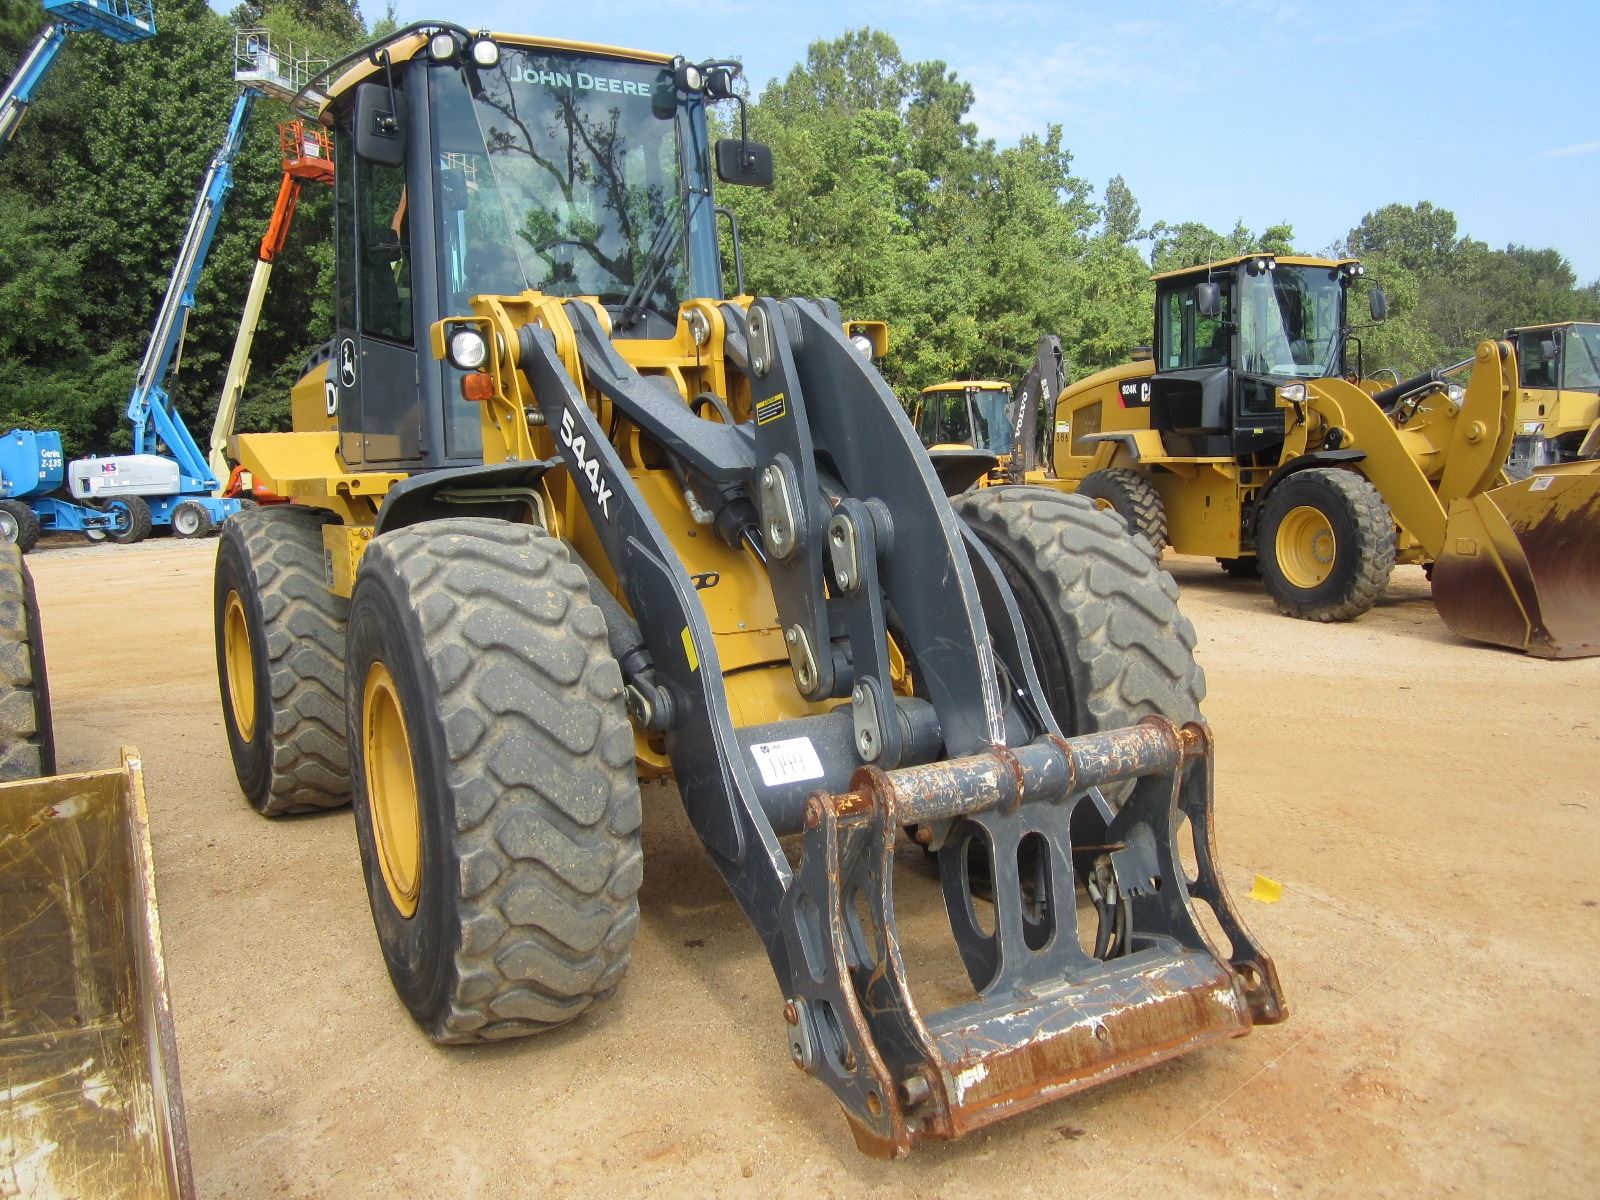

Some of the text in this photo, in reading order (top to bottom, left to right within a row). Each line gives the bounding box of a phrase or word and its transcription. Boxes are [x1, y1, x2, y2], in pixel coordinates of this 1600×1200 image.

[510, 65, 651, 97] JOHN DEERE
[1121, 384, 1138, 395] 924K
[1014, 391, 1028, 438] VOLVO
[41, 449, 61, 458] Genie
[560, 406, 613, 520] 544K
[101, 462, 117, 473] NES
